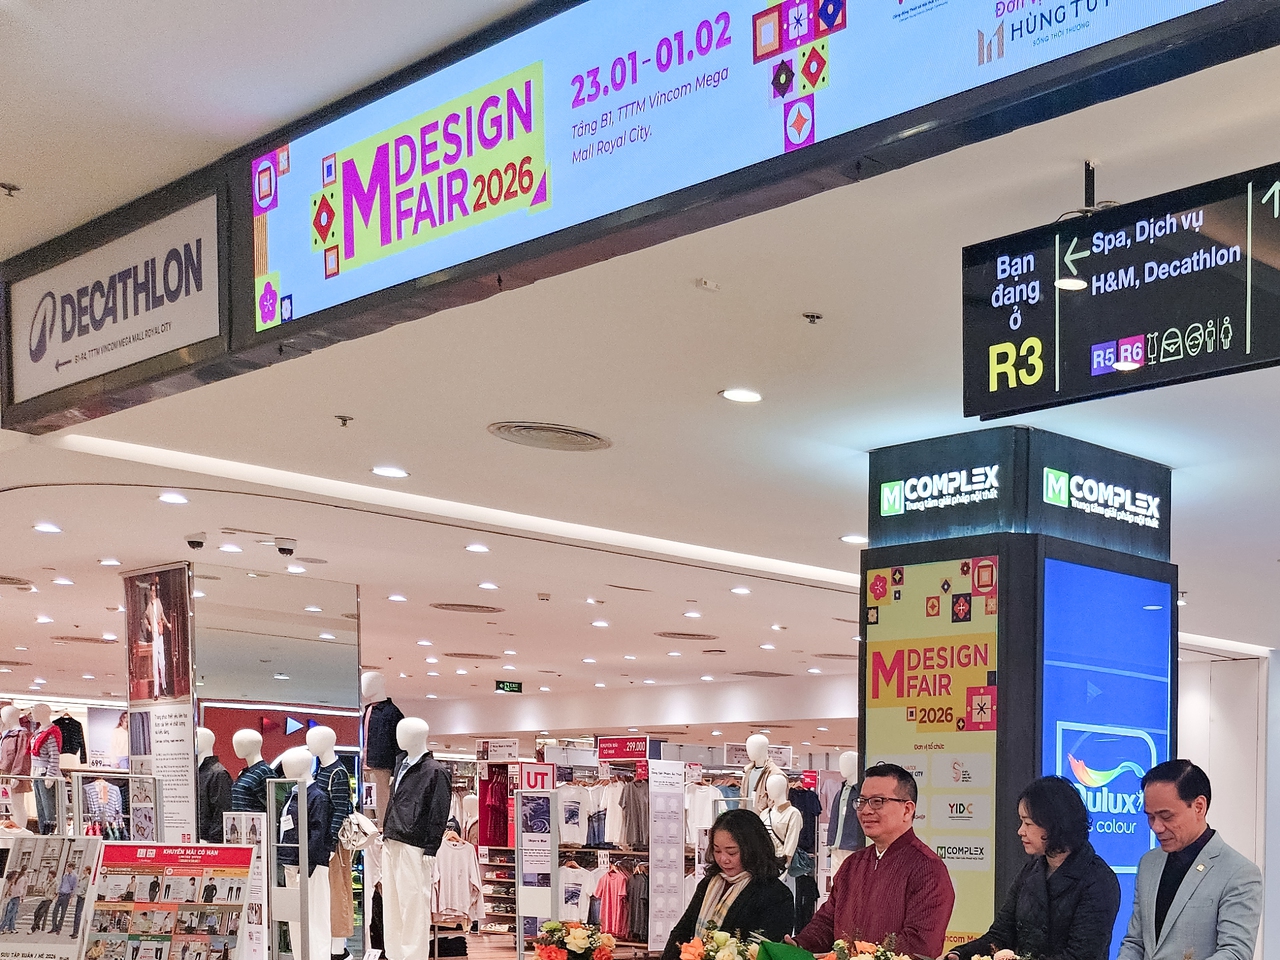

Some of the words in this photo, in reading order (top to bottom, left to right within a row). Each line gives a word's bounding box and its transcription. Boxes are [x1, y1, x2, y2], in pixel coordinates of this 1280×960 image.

[600, 111, 615, 129] B1,
[617, 97, 646, 122] TTTM
[648, 82, 692, 109] Vincom
[695, 67, 729, 91] Mega
[572, 144, 594, 164] Mall
[596, 130, 627, 156] Royal
[629, 125, 653, 143] City.
[342, 141, 393, 260] M
[394, 79, 534, 187] DESIGN
[396, 167, 470, 241] FAIR
[472, 155, 534, 213] 2026
[1091, 230, 1132, 256] Spa,
[1135, 212, 1178, 245] Dịch
[1181, 209, 1205, 233] vụ
[996, 252, 1036, 281] Bạn
[1091, 265, 1140, 297] H&M,
[1144, 244, 1242, 284] Decathlon
[60, 237, 204, 344] DECATHLON
[991, 280, 1041, 309] đang
[1009, 306, 1023, 331] ở
[988, 336, 1044, 393] R3
[1093, 346, 1116, 369] R5
[1119, 342, 1144, 366] R6
[904, 464, 1000, 500] COMPLEX
[1069, 475, 1161, 518] COMPLEX
[871, 650, 904, 699] M
[907, 643, 989, 672] DESIGN
[906, 673, 953, 698] FAIR
[918, 706, 954, 724] 2026
[526, 770, 549, 789] UT
[948, 803, 974, 814] YIDC
[1095, 818, 1137, 834] colour
[946, 846, 985, 856] COMPLEX
